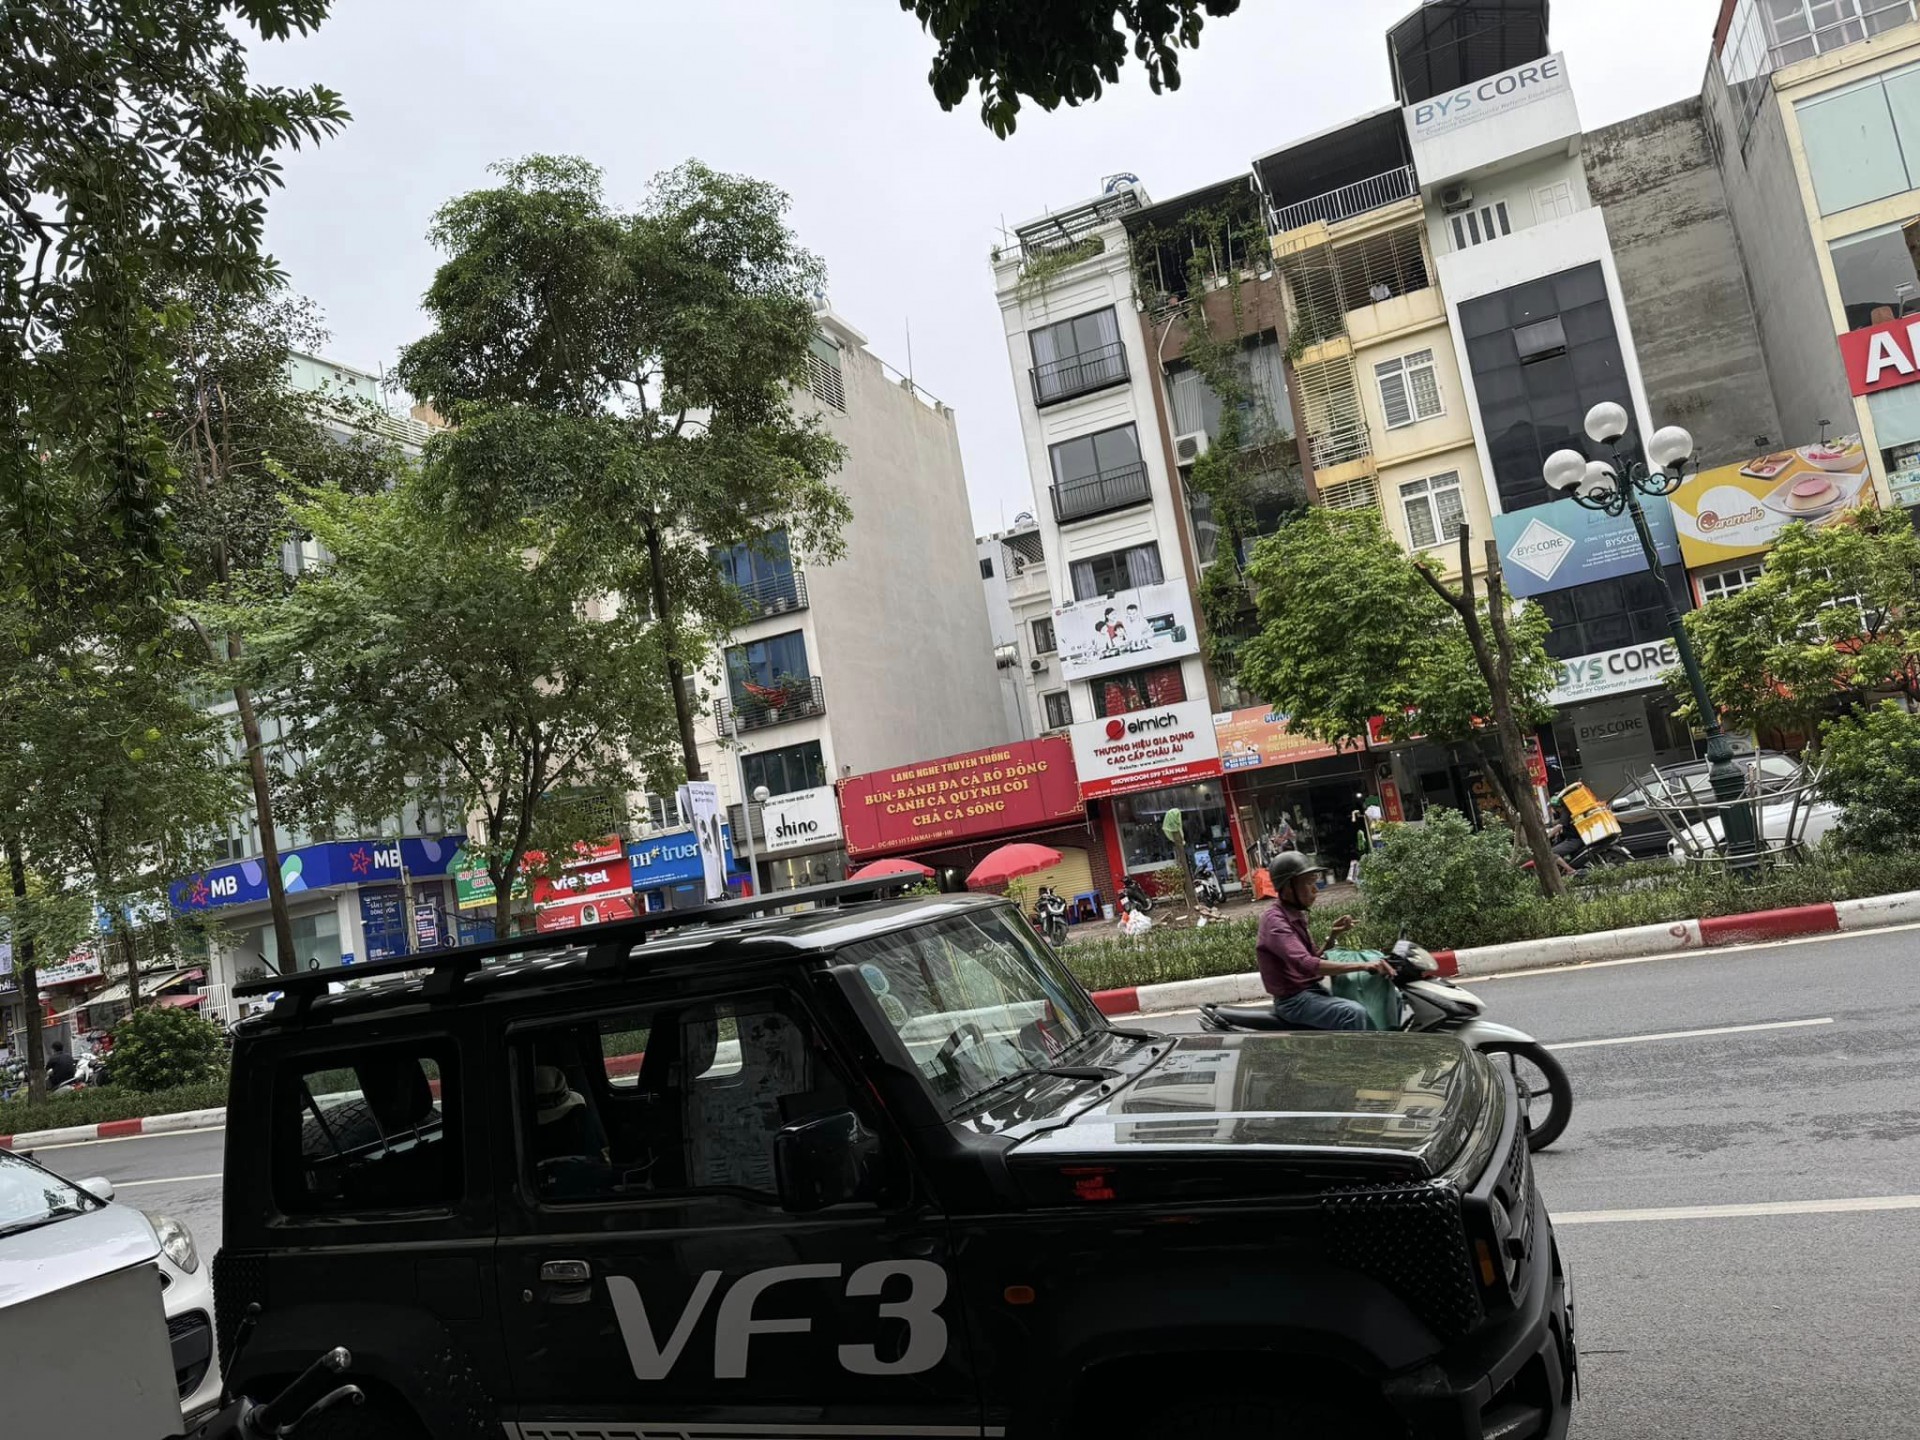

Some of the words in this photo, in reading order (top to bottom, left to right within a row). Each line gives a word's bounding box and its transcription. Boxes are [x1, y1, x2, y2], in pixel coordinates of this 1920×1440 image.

[1696, 506, 1765, 533] Caramello
[1127, 712, 1178, 734] elmich
[1093, 743, 1130, 757] THƯƠNG
[1131, 739, 1152, 751] HIỆU
[1153, 736, 1169, 747] GIA
[1170, 731, 1195, 743] DỤNG
[1107, 754, 1126, 765] CAO
[1127, 749, 1145, 761] CẤP
[1146, 745, 1170, 758] CHÂU
[891, 769, 915, 783] LÀNG
[916, 762, 940, 778] NGHỀ
[979, 750, 1011, 766] THỐNG
[960, 771, 981, 787] CÁ
[983, 766, 1001, 781] RÔ
[1006, 758, 1048, 778] ĐỒNG
[886, 799, 925, 814] CANH
[927, 791, 947, 807] CÁ
[950, 782, 1001, 804] QUỲNH
[775, 812, 818, 838] shino
[912, 807, 941, 826] CHẢ
[944, 805, 963, 820] CÁ
[966, 799, 1005, 817] SÔNG
[373, 849, 401, 869] MB
[629, 852, 652, 868] TH
[211, 875, 238, 898] MB
